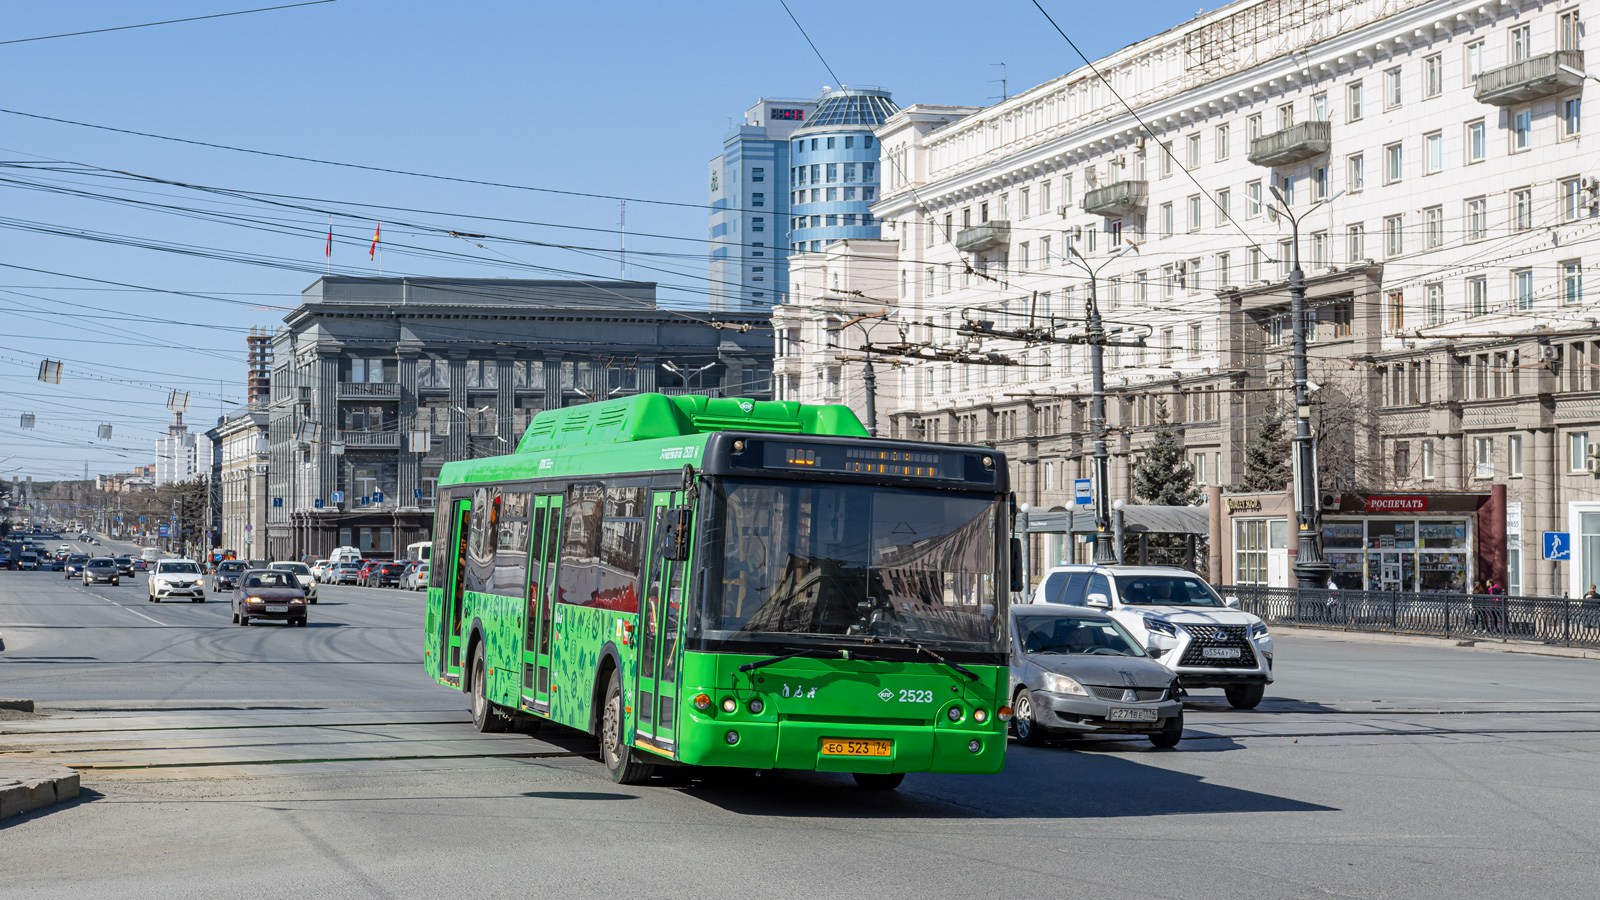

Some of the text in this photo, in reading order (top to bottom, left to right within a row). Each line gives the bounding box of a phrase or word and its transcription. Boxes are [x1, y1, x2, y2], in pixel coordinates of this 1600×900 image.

[1371, 499, 1424, 508] РОСПЕЧАТЬ
[898, 689, 934, 704] 2523
[829, 741, 887, 754] ЕО 523 74
